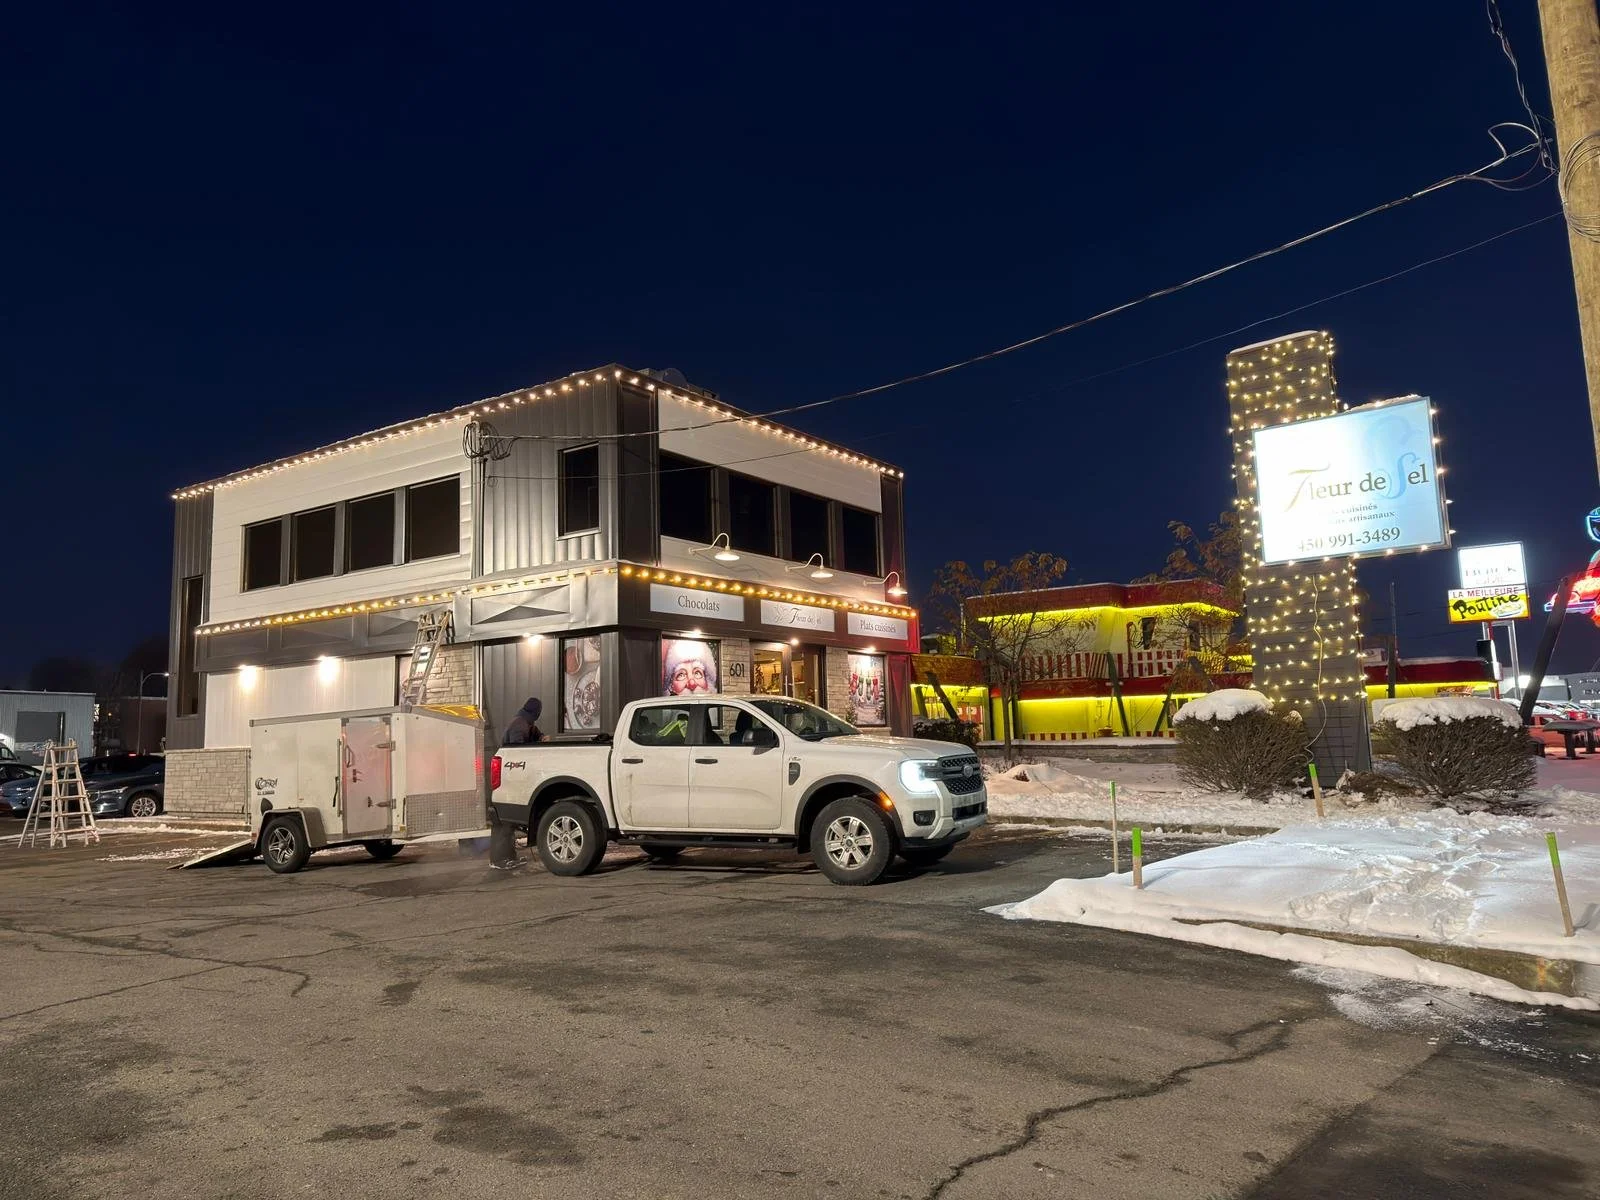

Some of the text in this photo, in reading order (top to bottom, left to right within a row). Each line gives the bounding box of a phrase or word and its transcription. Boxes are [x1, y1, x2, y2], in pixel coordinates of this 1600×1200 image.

[1285, 452, 1429, 511] Fleur de Sel
[1348, 510, 1395, 523] artisanaux
[1328, 526, 1401, 548] 991-3489
[1452, 587, 1519, 599] LA MEILLEURE
[677, 594, 720, 612] Chocolats
[1453, 594, 1520, 619] Poutine
[859, 618, 874, 631] Plats
[729, 662, 745, 678] 601
